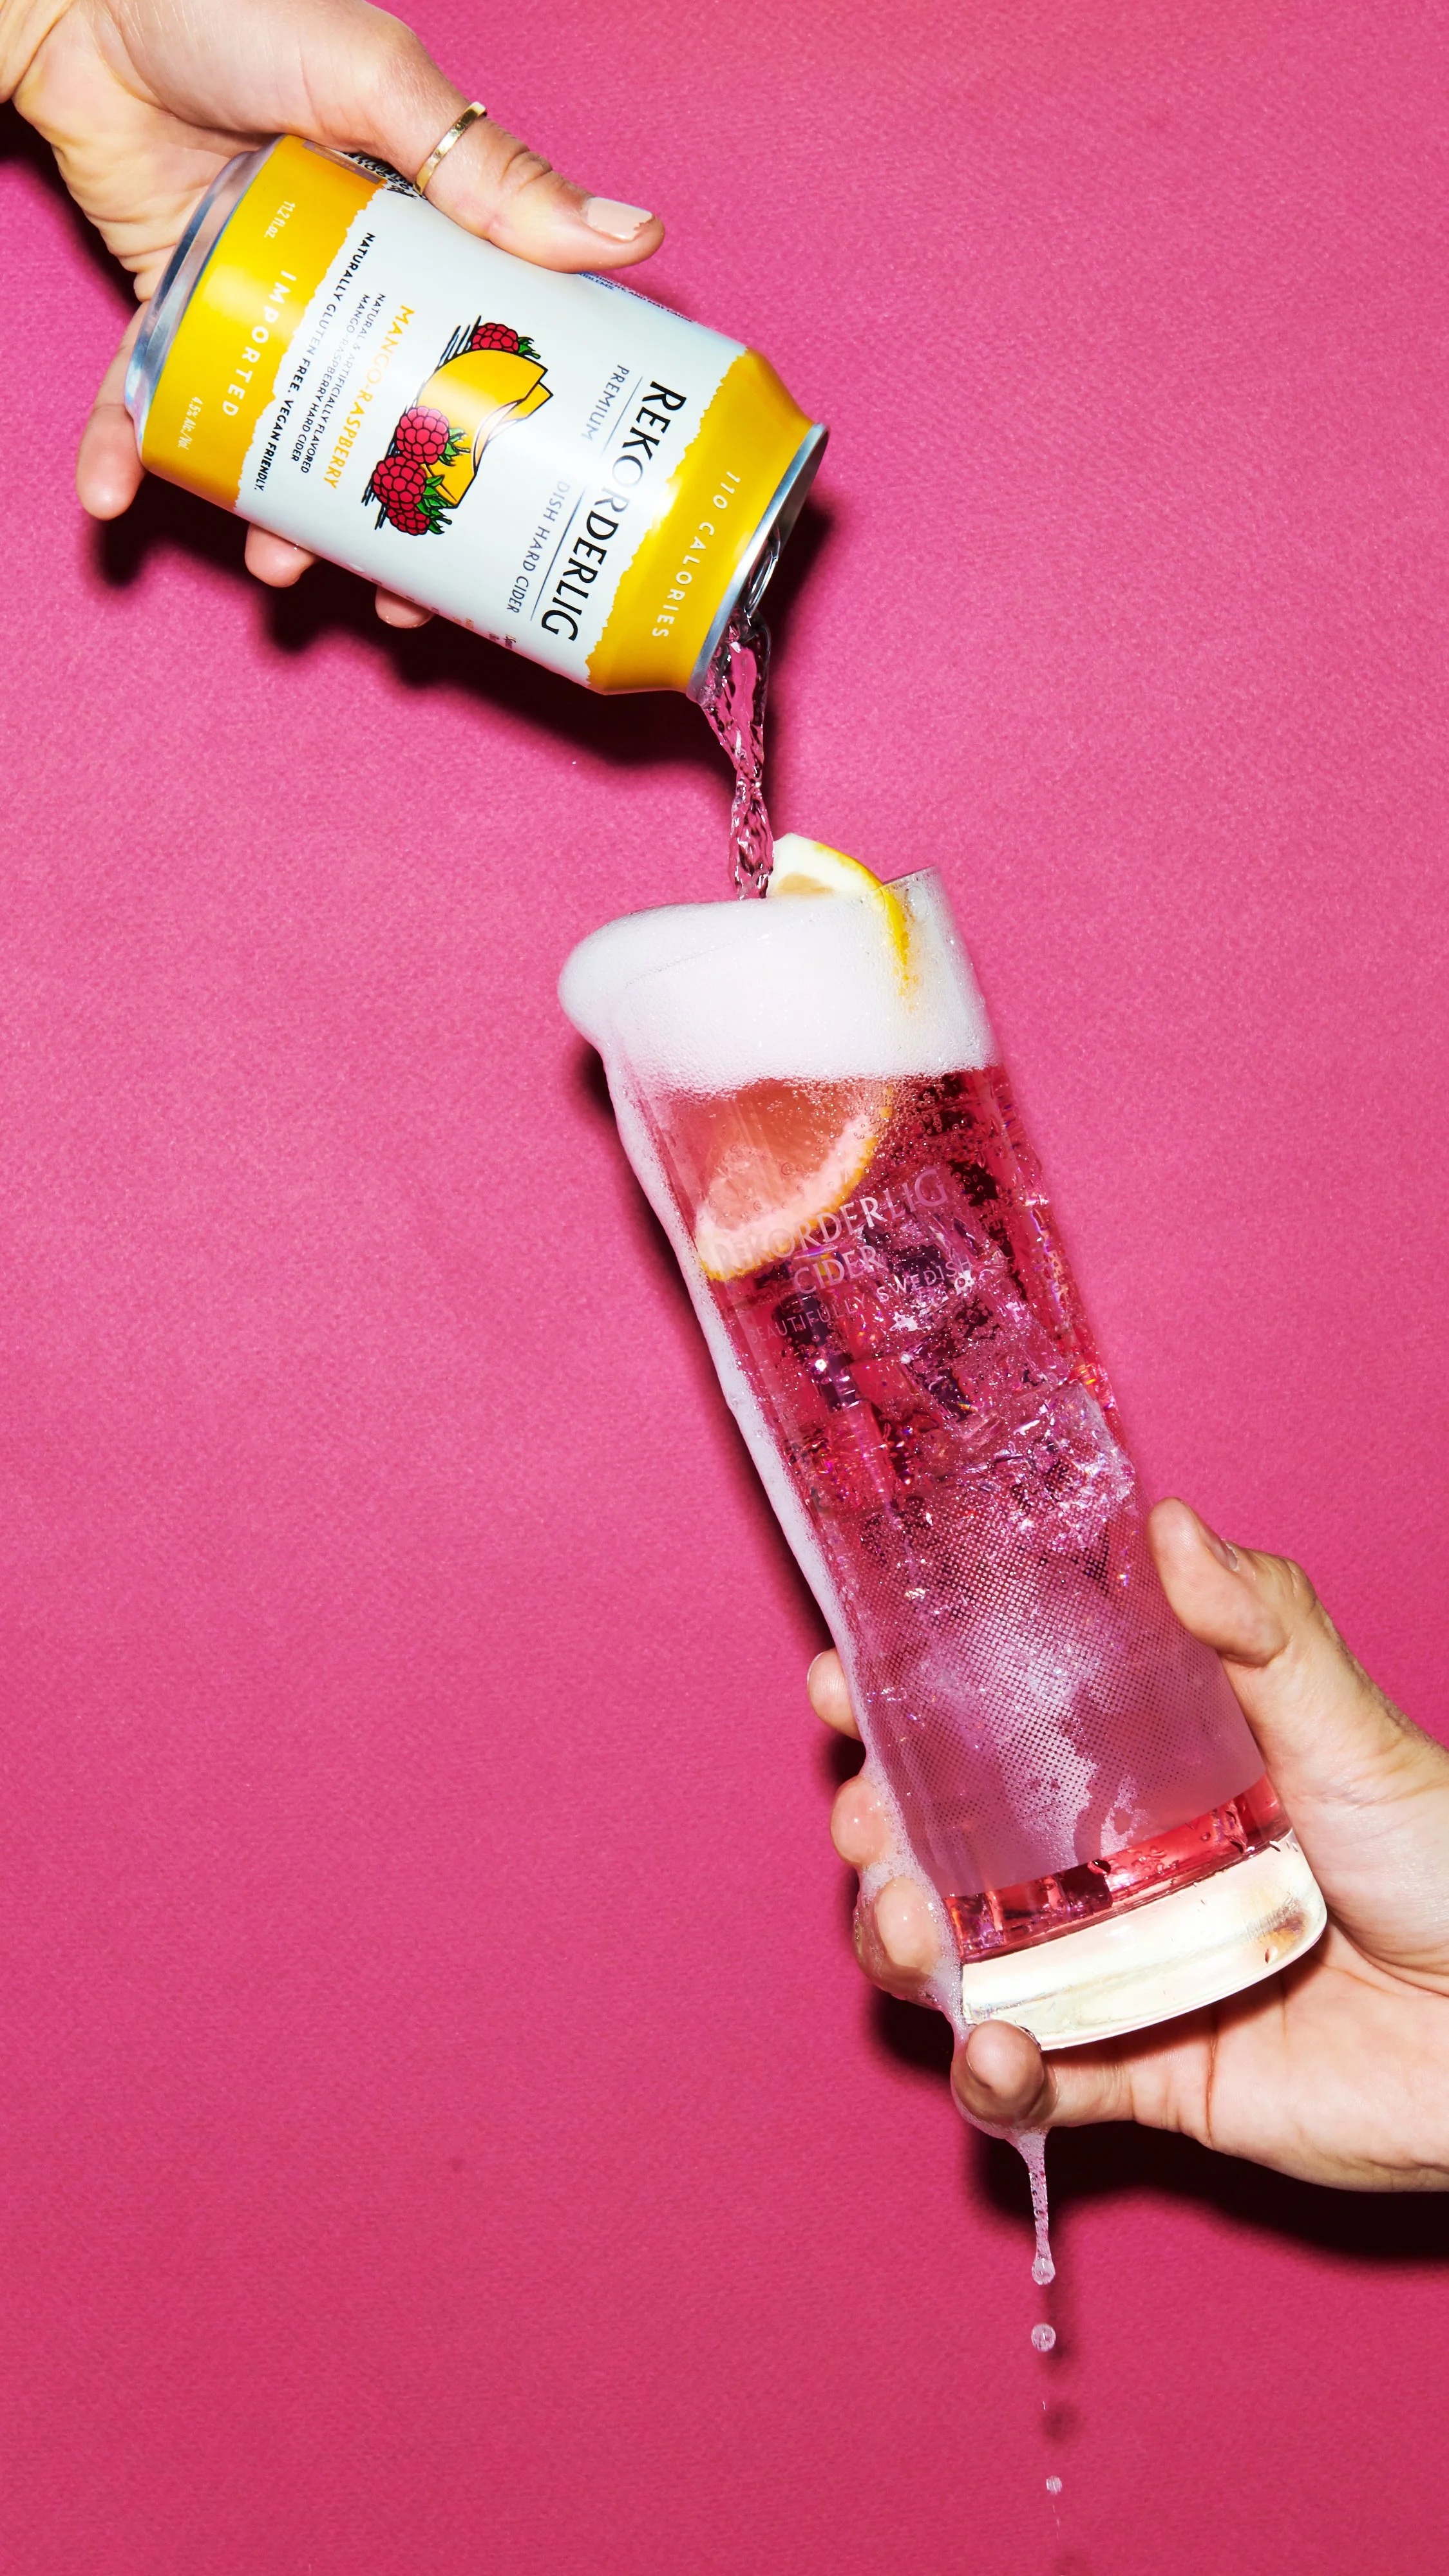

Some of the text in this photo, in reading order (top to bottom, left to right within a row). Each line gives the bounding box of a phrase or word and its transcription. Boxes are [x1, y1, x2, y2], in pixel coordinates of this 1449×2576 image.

[277, 200, 296, 219] 11.2
[222, 270, 297, 417] IMPORTED
[356, 293, 386, 340] NATURAL
[254, 232, 376, 491] NATURALLY GLUTEN FREE. VEGAN FRIENDLY.
[290, 294, 371, 462] MANGO-RASPBERRY HARD CIDER
[321, 352, 355, 423] ARTIFICIALLY
[323, 305, 415, 489] MANGO-RASPBERRY
[186, 396, 204, 419] 4.5%
[581, 365, 630, 441] PREMIUM
[301, 424, 325, 473] FLAVORED
[541, 381, 687, 641] REKORDERLIG
[523, 526, 550, 572] HARD
[652, 471, 741, 637] 110 CALORIES
[506, 575, 529, 613] CIDER
[748, 1256, 971, 1343] BEAUTIFULLY SWEDISH
[793, 1245, 885, 1294] CIDER
